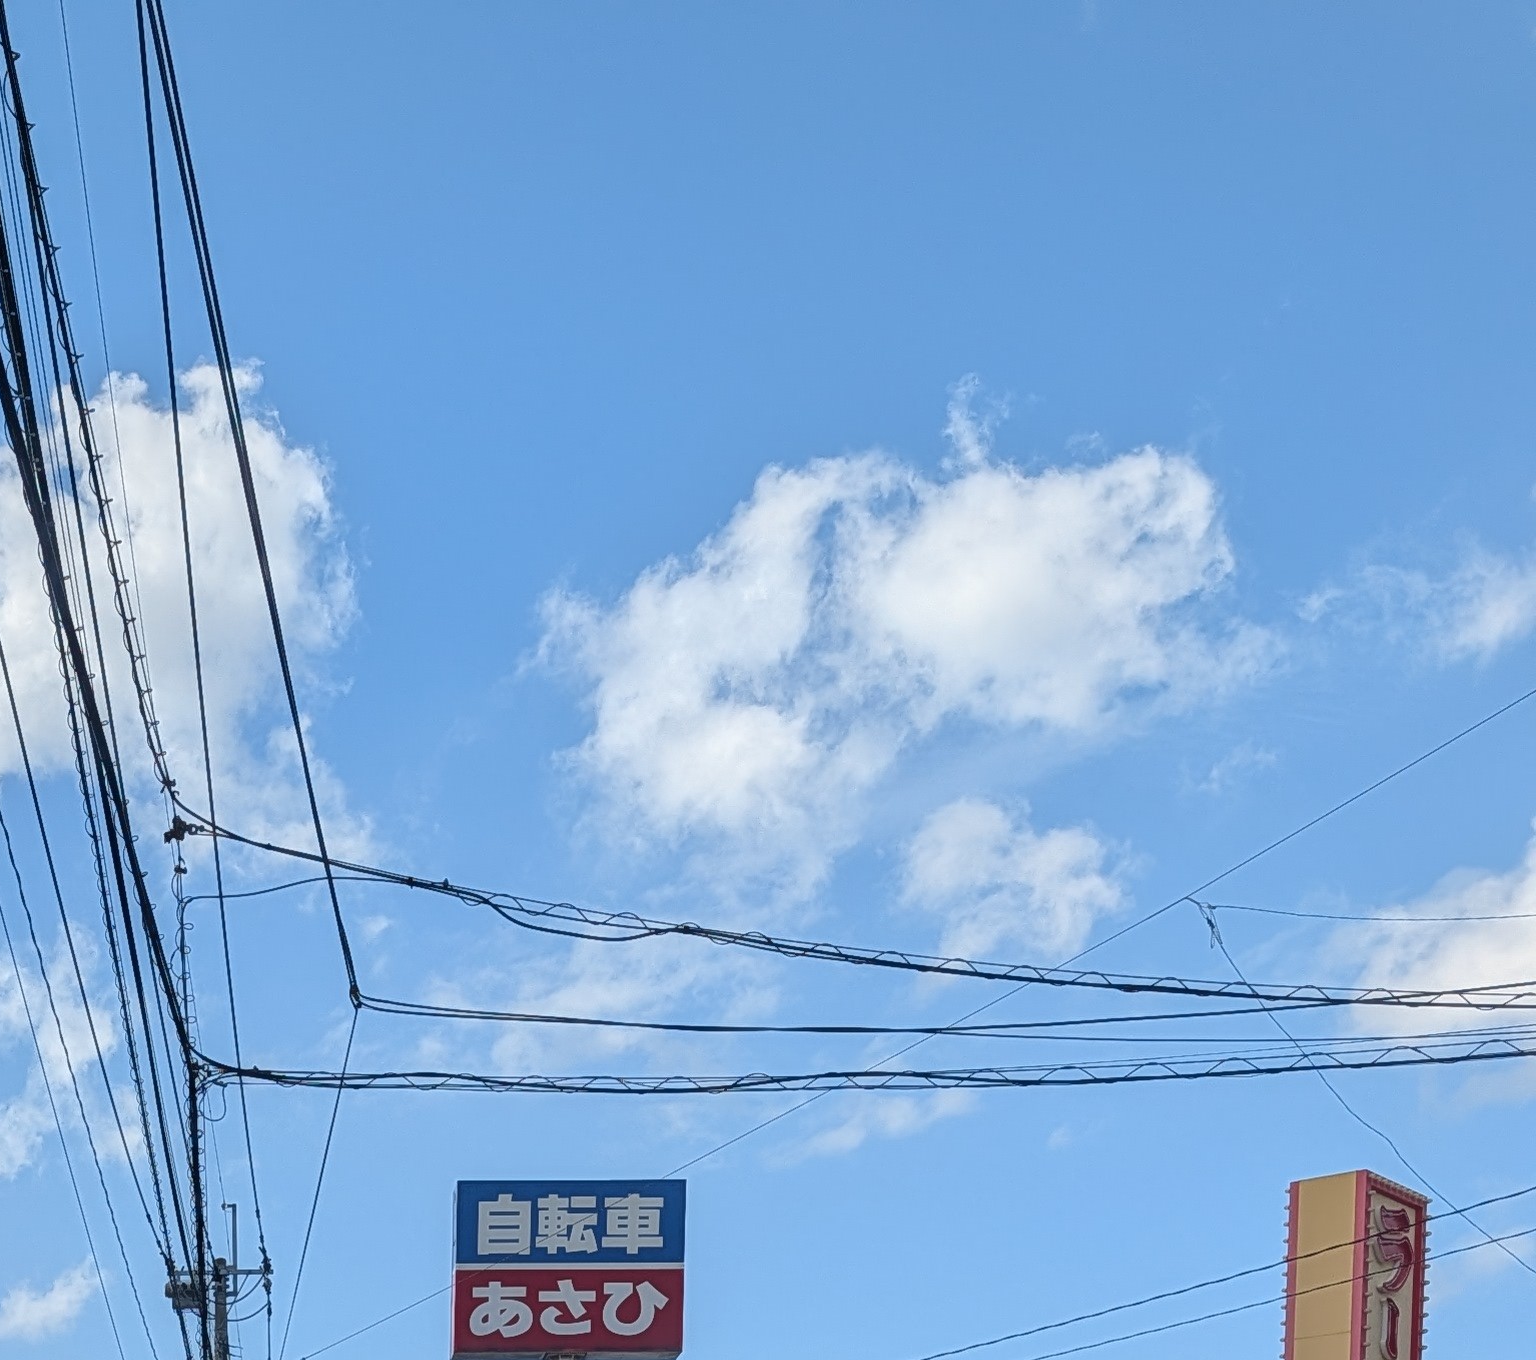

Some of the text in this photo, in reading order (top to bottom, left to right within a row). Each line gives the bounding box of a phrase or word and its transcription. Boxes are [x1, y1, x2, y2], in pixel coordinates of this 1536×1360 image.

[478, 1193, 664, 1255] 自転車
[469, 1280, 670, 1337] あさひ
